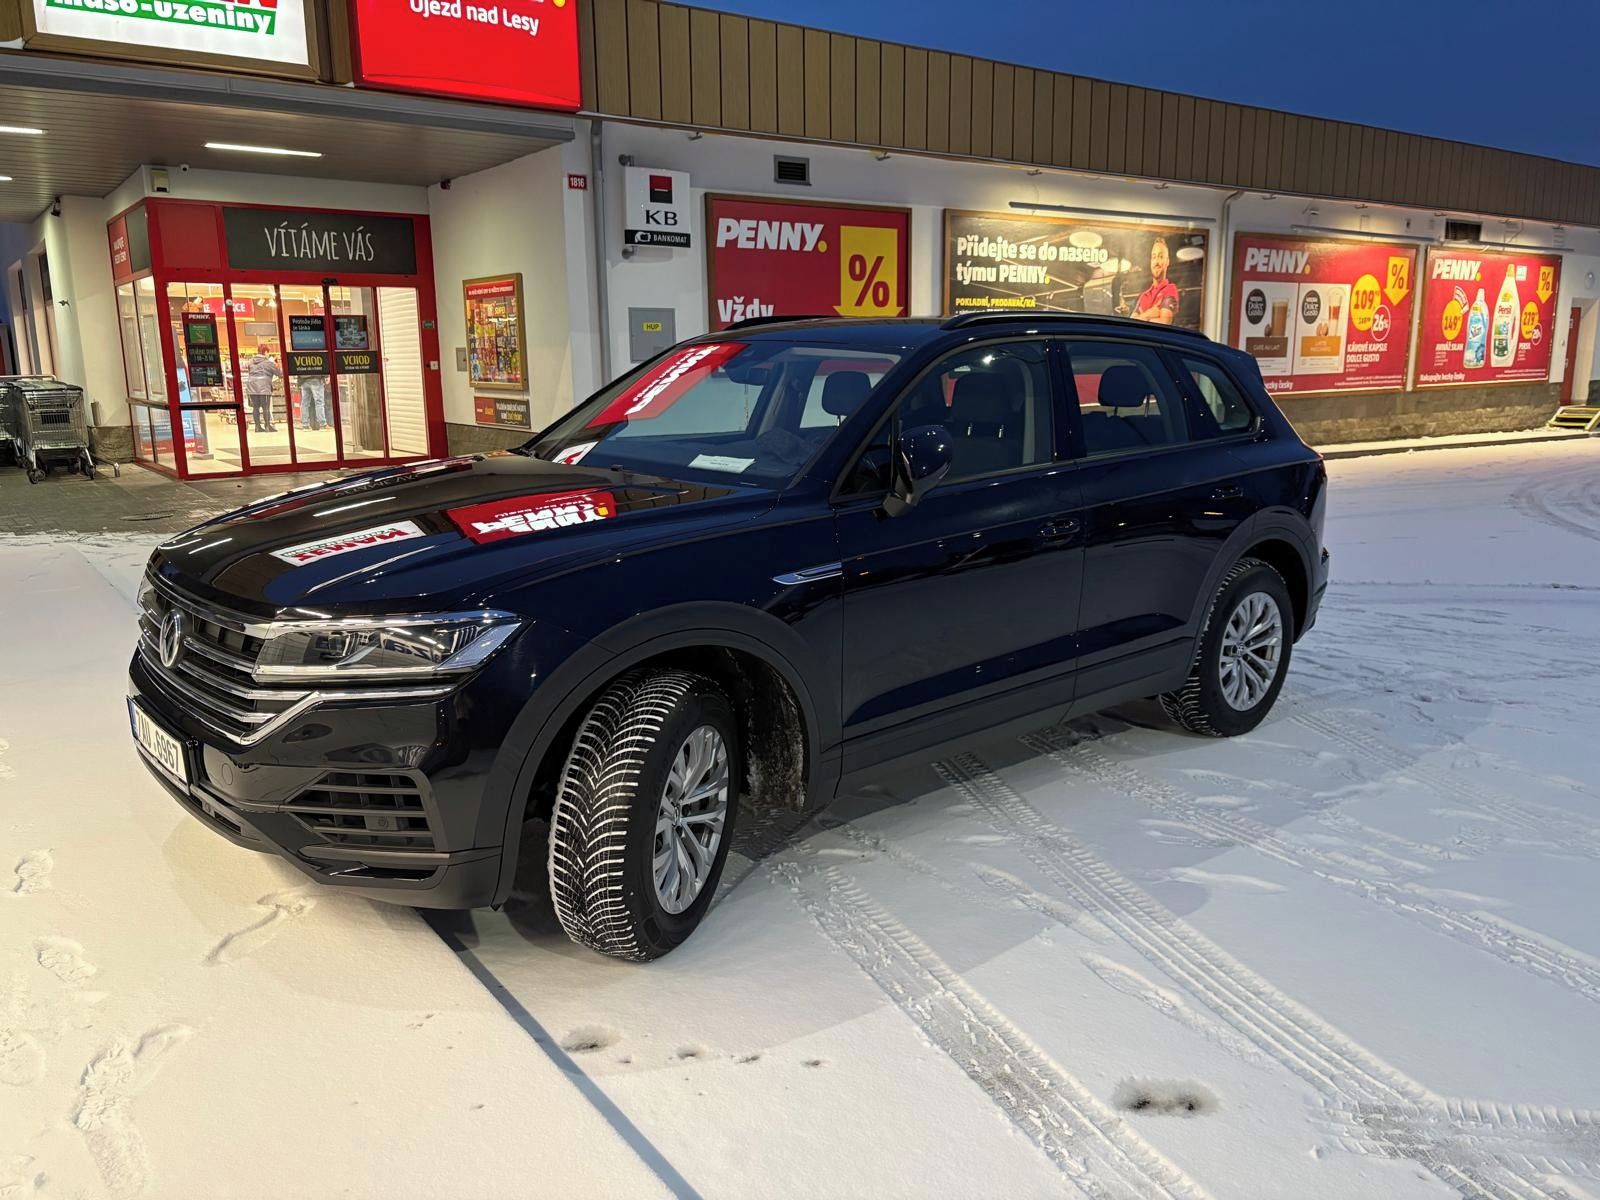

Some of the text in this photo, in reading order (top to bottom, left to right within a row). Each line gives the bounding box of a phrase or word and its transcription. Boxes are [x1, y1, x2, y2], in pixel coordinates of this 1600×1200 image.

[466, 5, 499, 25] nad
[503, 9, 540, 36] Lesy
[569, 175, 586, 189] 1816
[645, 209, 678, 226] KB
[264, 221, 375, 262] VÍTÁME VÁS
[653, 234, 687, 244] BANKOMAT
[957, 235, 1017, 262] Přidejte
[1019, 244, 1037, 260] se
[1038, 242, 1057, 261] do
[956, 261, 997, 285] týmu
[294, 356, 323, 367] VCHOD
[342, 355, 370, 365] VCHOD
[155, 729, 179, 773] 6967
